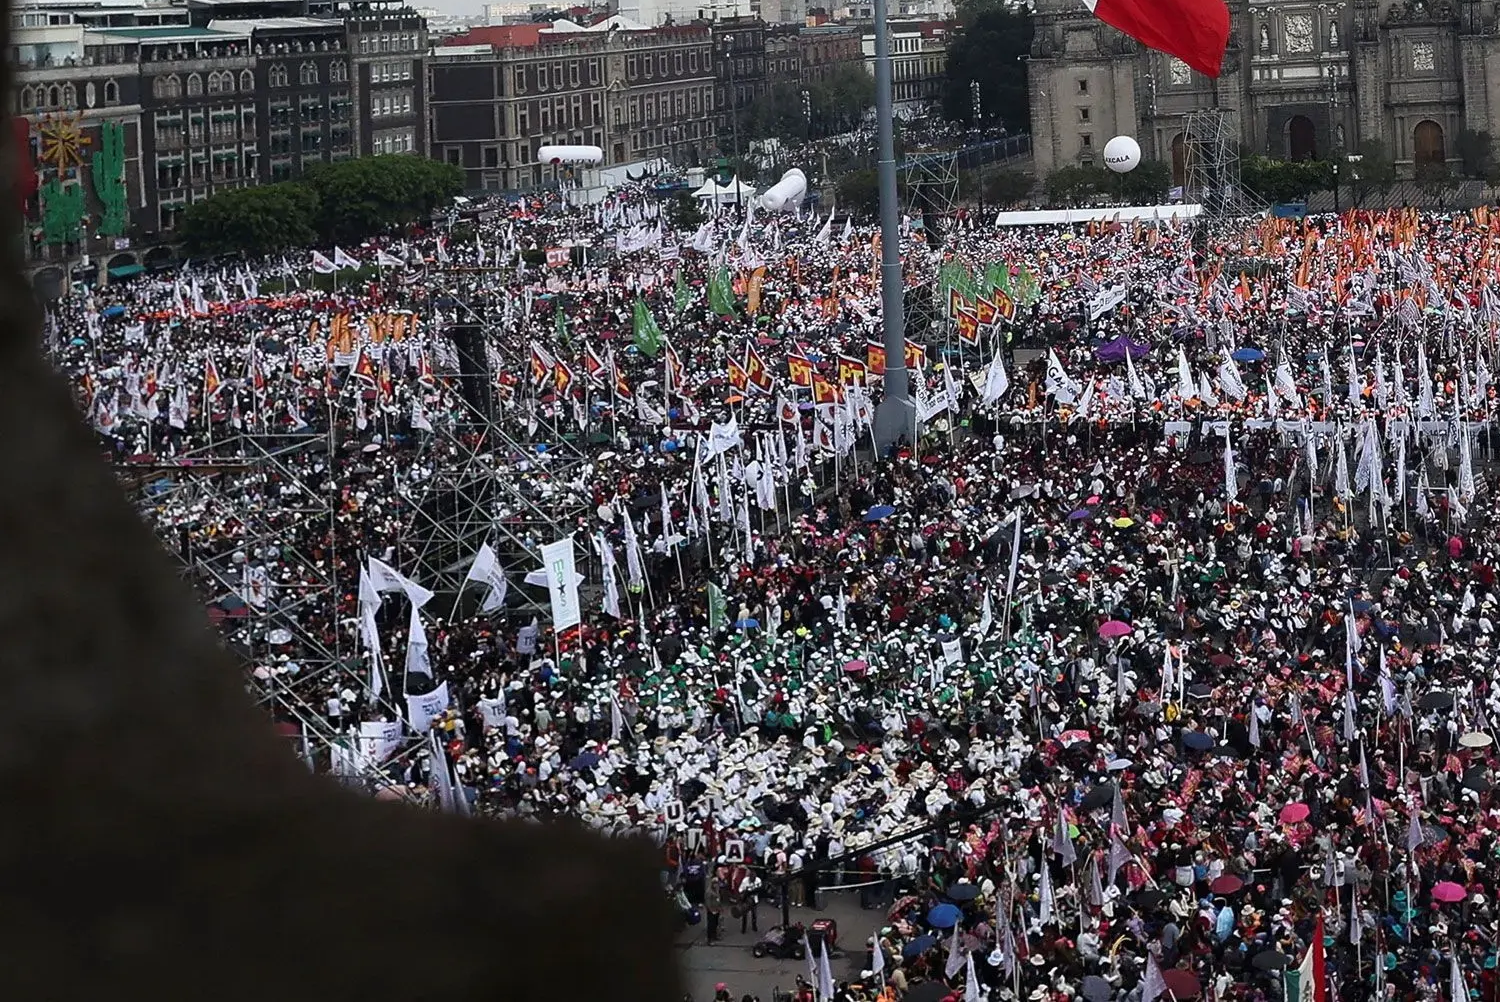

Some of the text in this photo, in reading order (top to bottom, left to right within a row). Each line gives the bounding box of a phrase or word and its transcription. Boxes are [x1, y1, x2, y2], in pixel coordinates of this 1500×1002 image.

[547, 248, 570, 262] CTC
[789, 362, 811, 386] PT
[840, 364, 864, 388] PT
